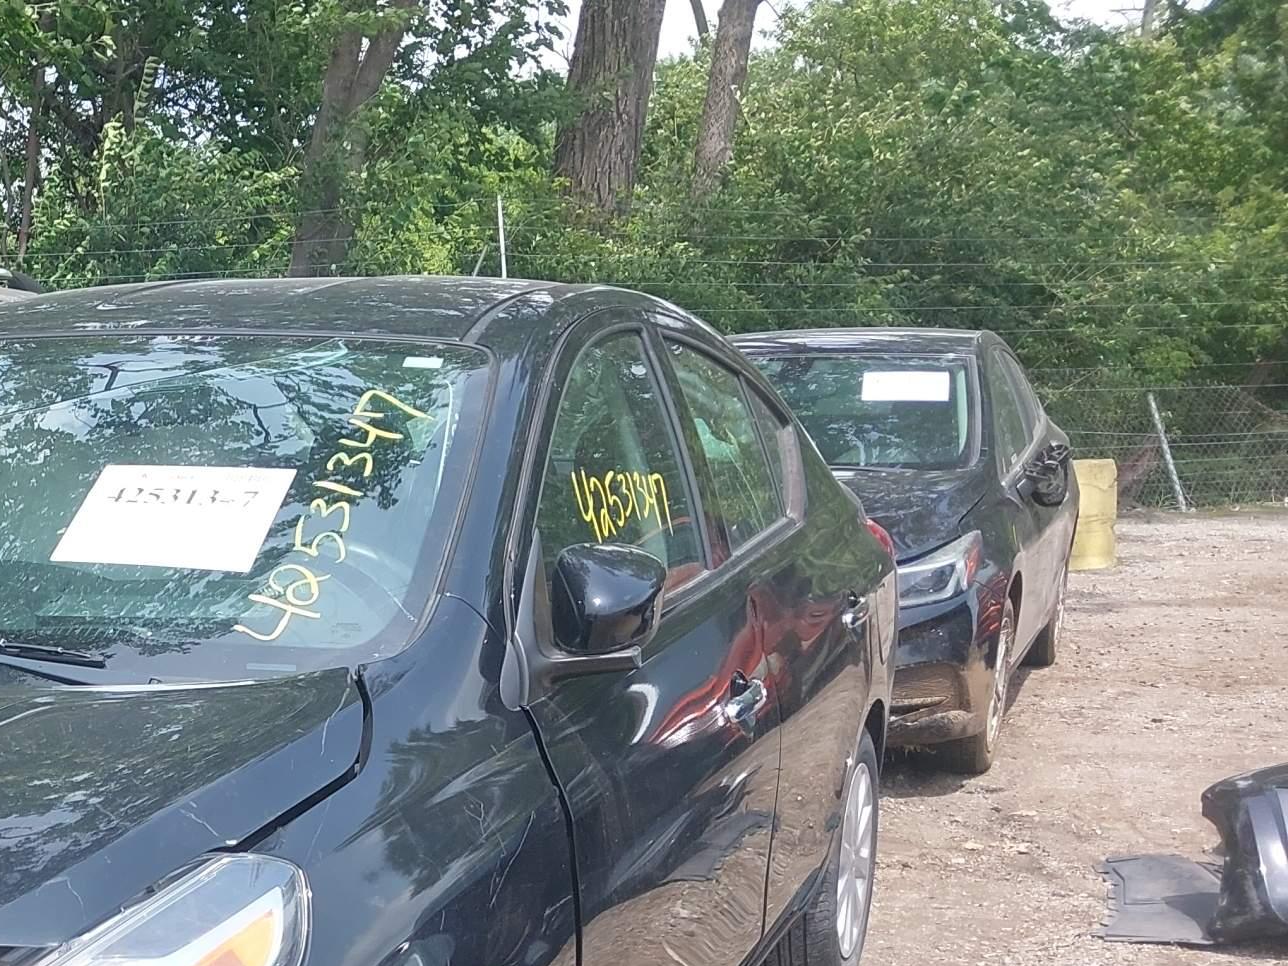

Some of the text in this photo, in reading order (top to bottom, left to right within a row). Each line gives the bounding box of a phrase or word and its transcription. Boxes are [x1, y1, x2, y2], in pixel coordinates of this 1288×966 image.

[106, 487, 260, 509] 4253137
[233, 388, 434, 641] 42531347
[570, 469, 674, 544] 42531347
